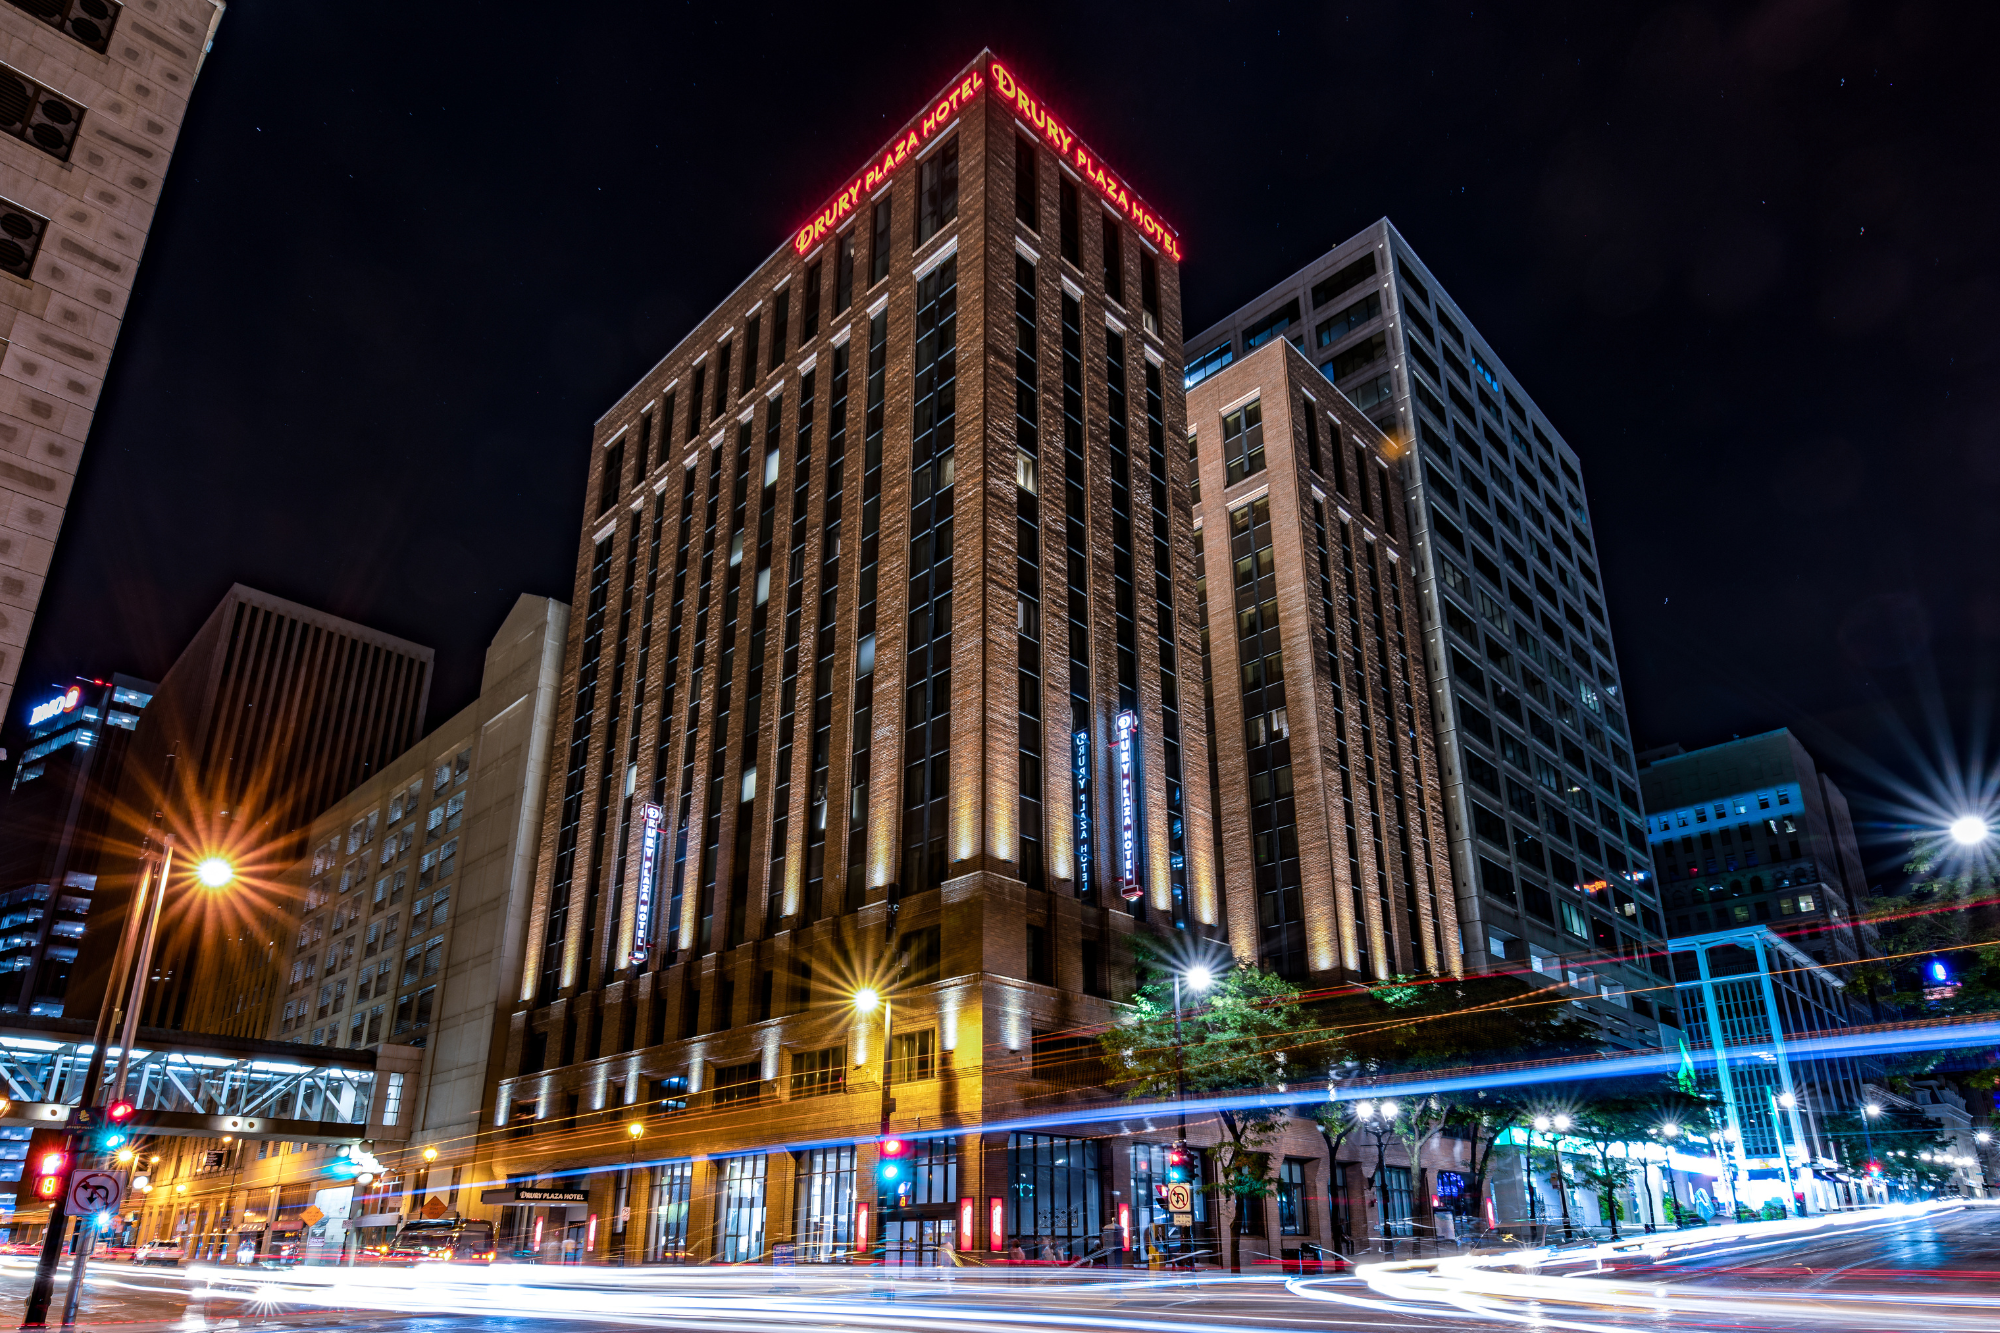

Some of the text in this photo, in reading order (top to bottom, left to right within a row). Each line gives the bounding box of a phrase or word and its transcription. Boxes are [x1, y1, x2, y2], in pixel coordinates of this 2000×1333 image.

[795, 71, 983, 255] DRURY PLAZA HOTEL
[991, 62, 1182, 262] DRURY PLAZA HOTEL
[638, 807, 659, 945] DRURY PLAZA HOTEL
[1118, 715, 1133, 879] DRURY PLAZA HOTEL
[520, 1191, 543, 1200] DRURY
[543, 1192, 563, 1200] PLAZA
